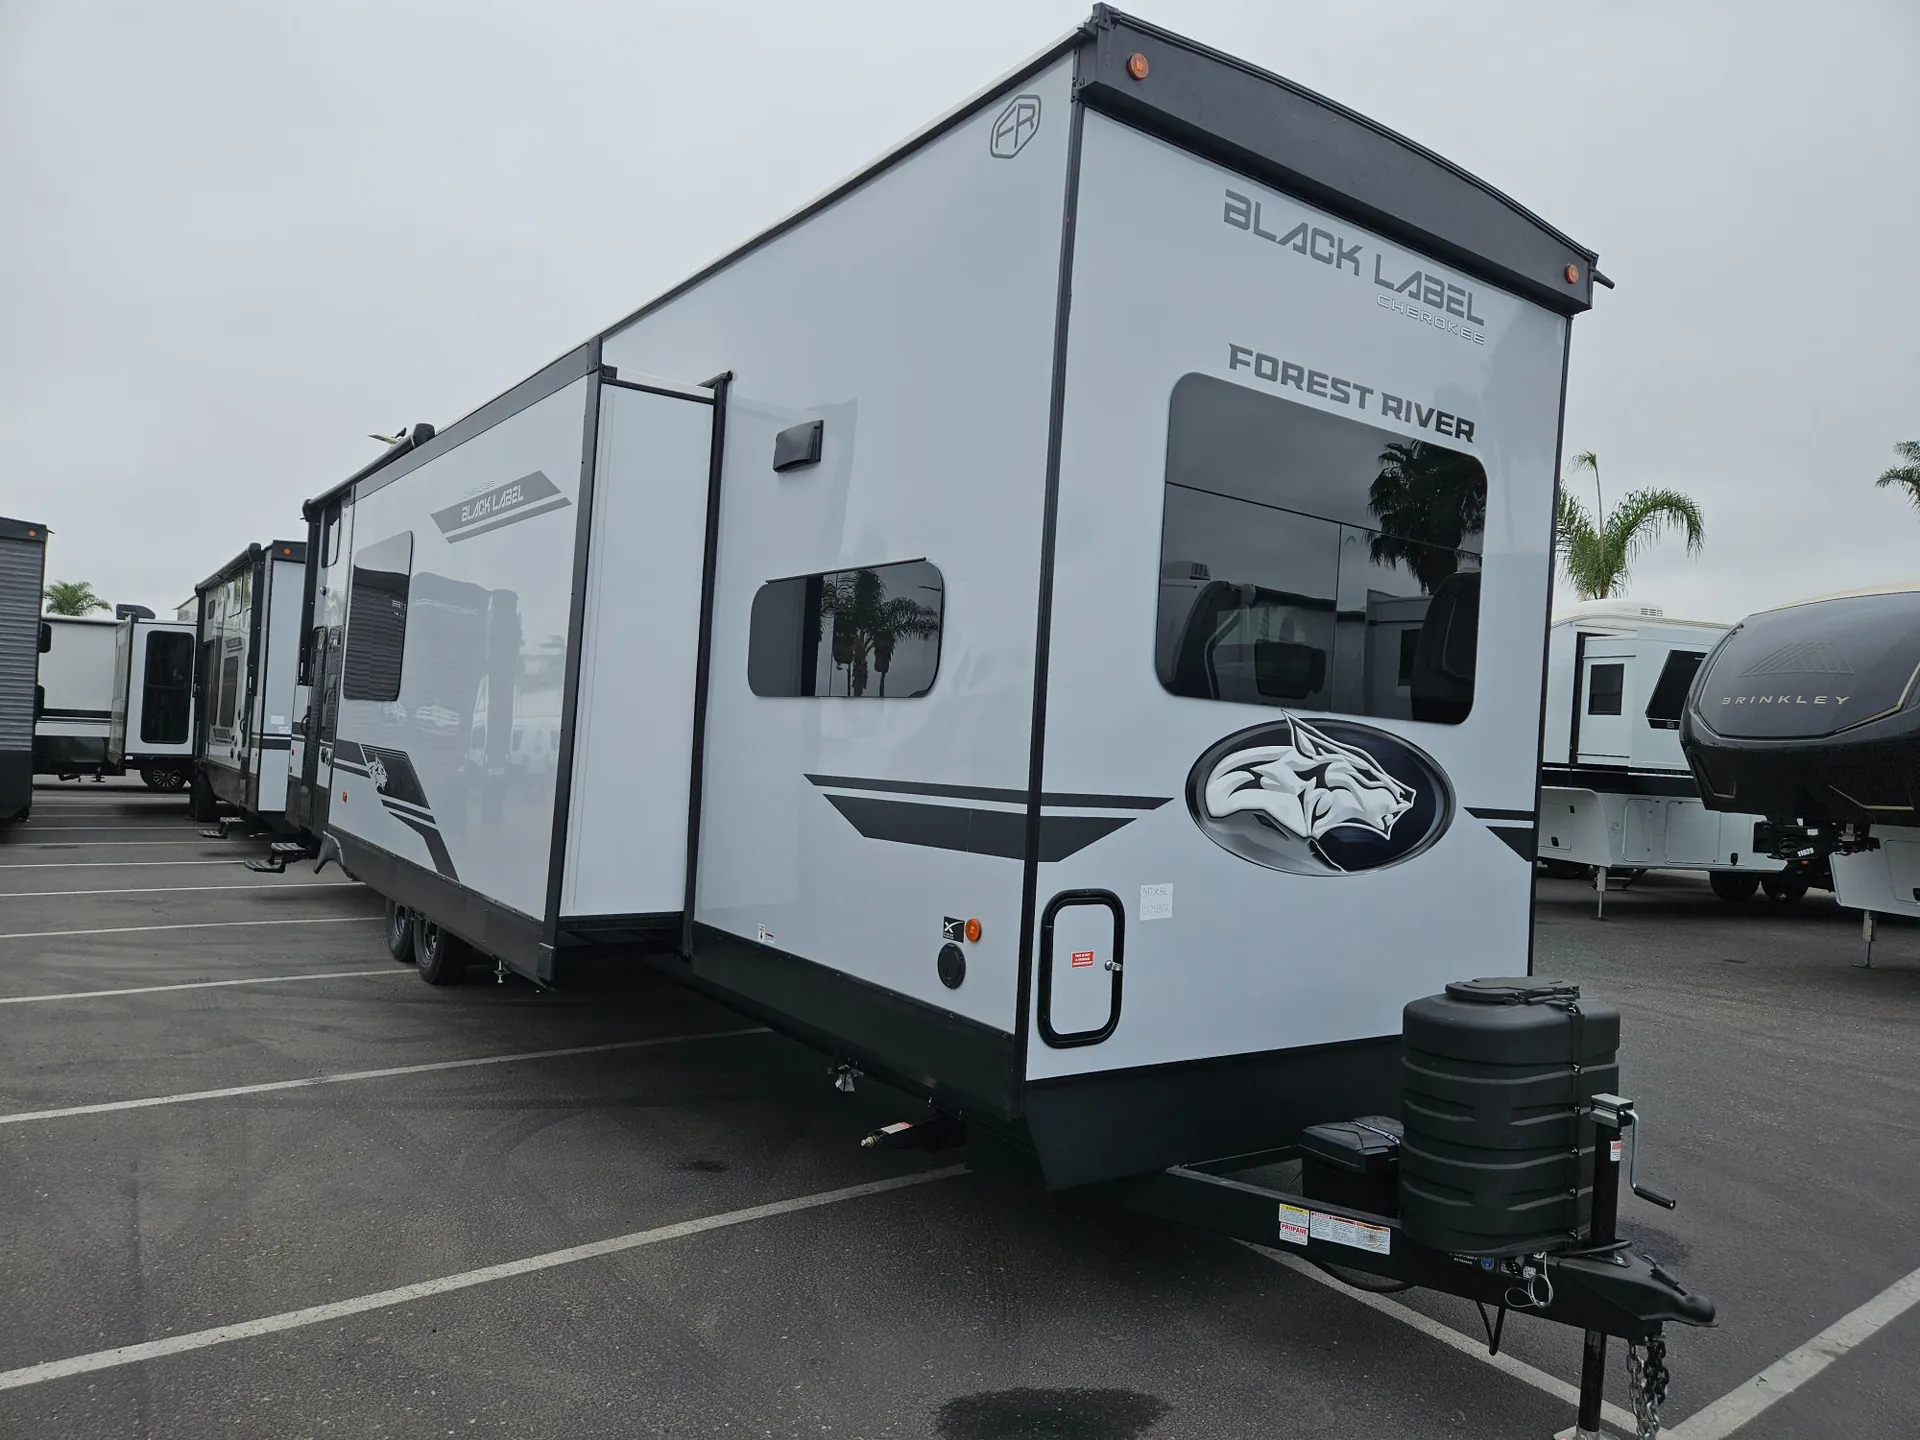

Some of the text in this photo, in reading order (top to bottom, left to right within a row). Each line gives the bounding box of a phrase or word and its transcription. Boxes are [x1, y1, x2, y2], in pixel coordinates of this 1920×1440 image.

[1223, 188, 1485, 326] BLACK LABEL
[1376, 293, 1485, 346] CHEROKEE
[1228, 342, 1476, 443] FOREST RIVER
[461, 496, 491, 522] BLACK
[492, 484, 524, 511] LABEL
[1721, 695, 1851, 705] BRINKLEY
[1281, 1223, 1308, 1236] PROPANE
